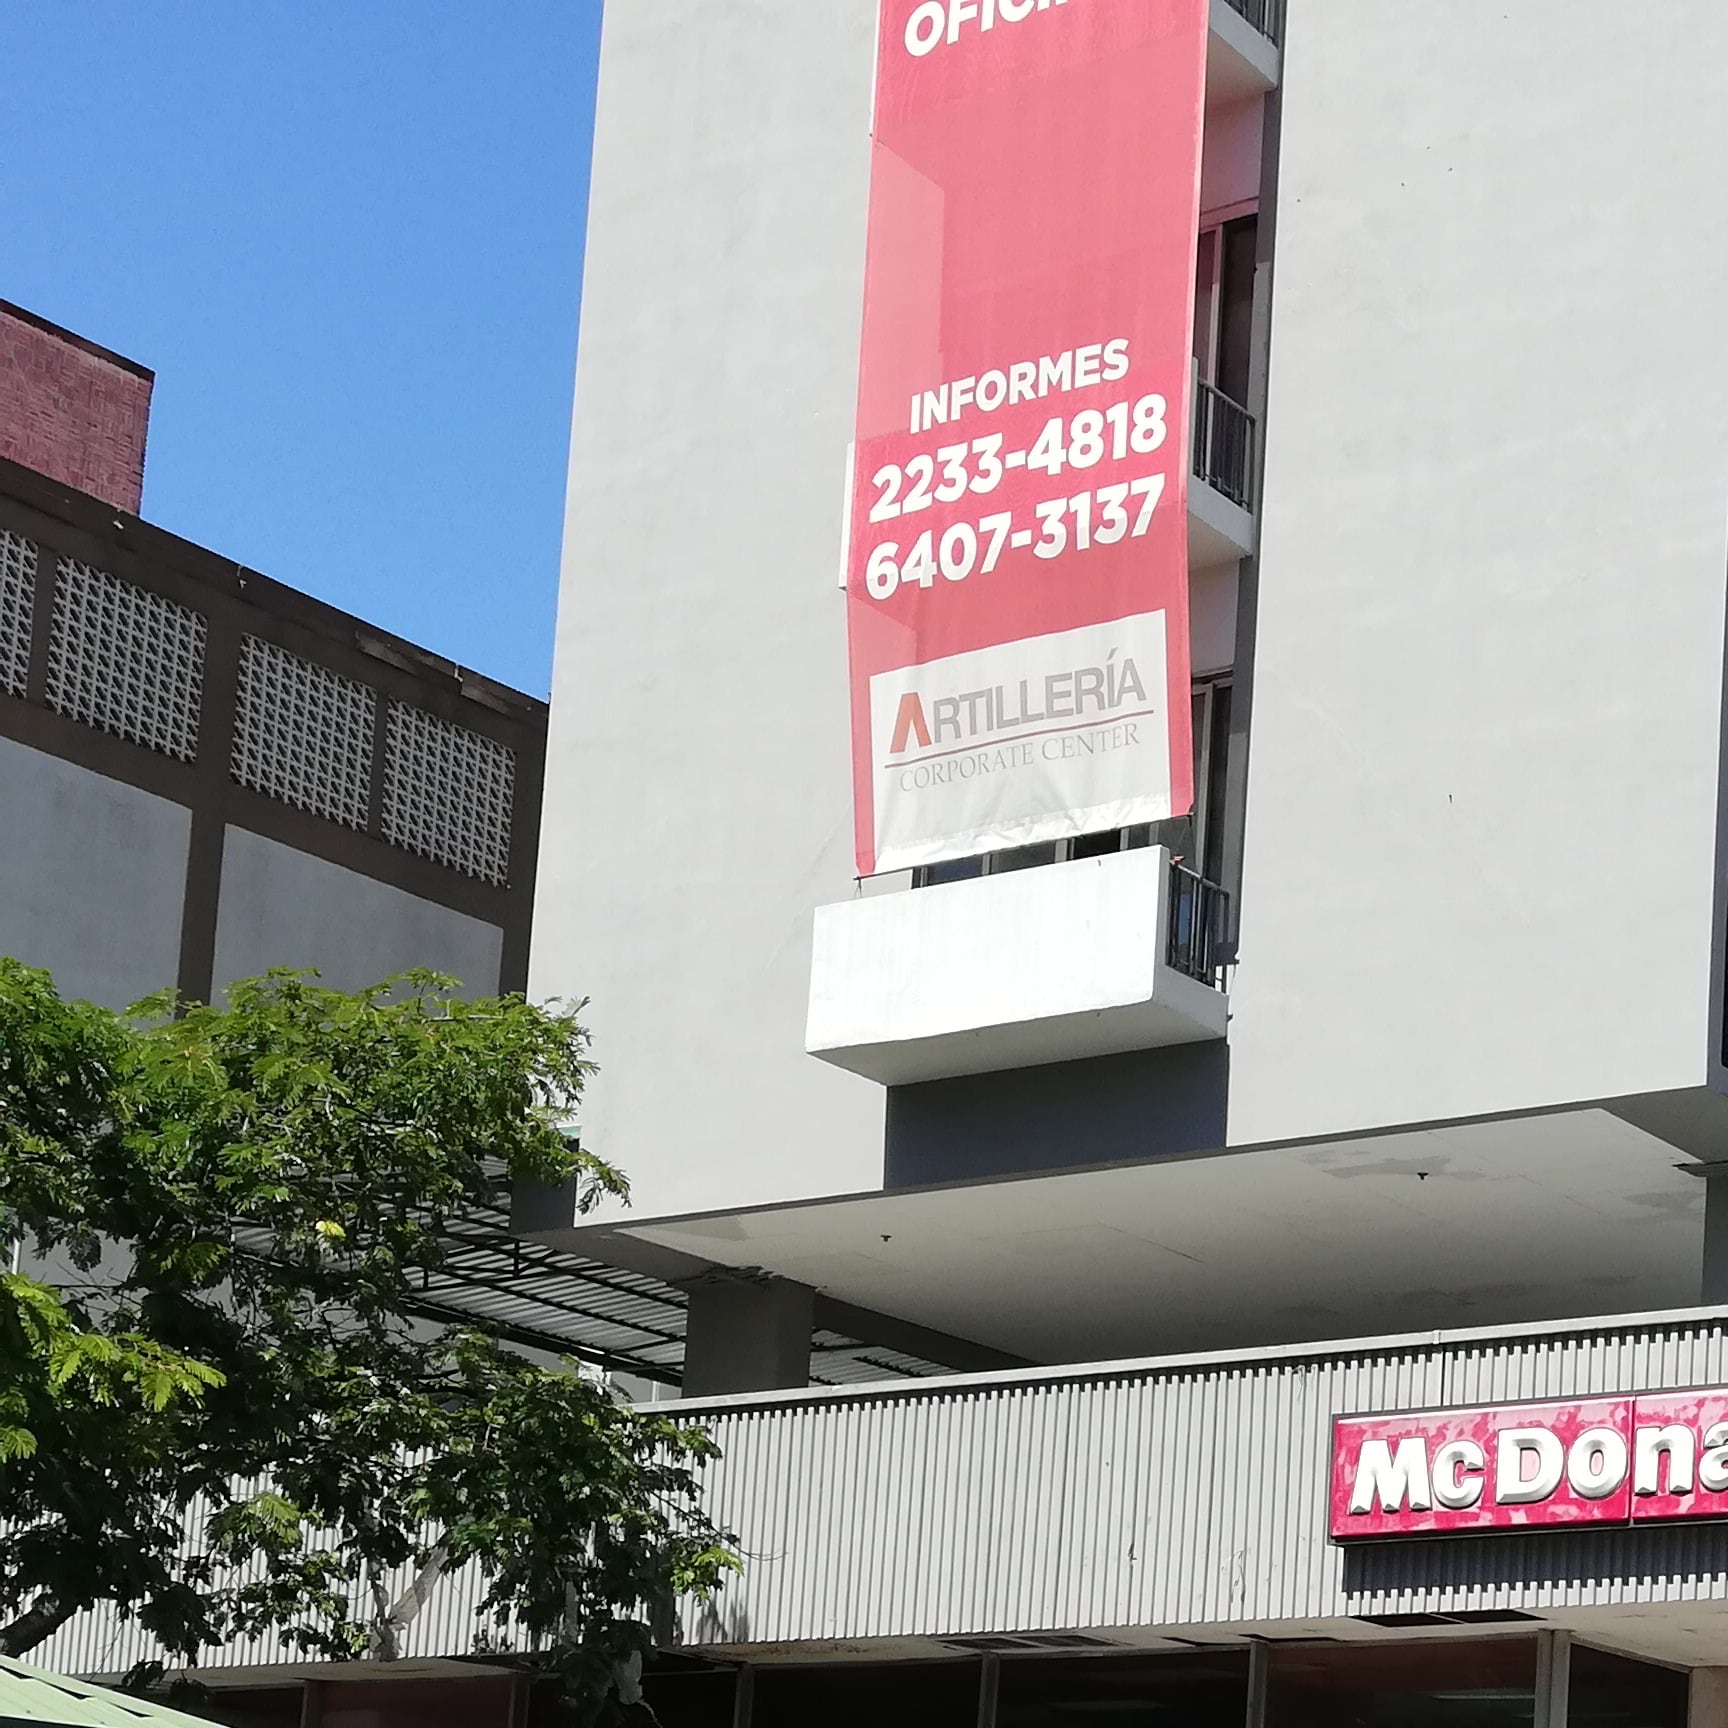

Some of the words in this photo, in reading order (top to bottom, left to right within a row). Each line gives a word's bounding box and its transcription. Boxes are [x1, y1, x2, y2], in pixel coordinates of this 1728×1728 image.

[909, 338, 1130, 434] INFORMES
[868, 393, 1167, 523] 2233-4818
[865, 473, 1166, 600] 6407-3137
[889, 647, 1148, 753] ARTILLERÍA
[899, 743, 1034, 793] CORPORATE
[1041, 722, 1140, 761] CENTER
